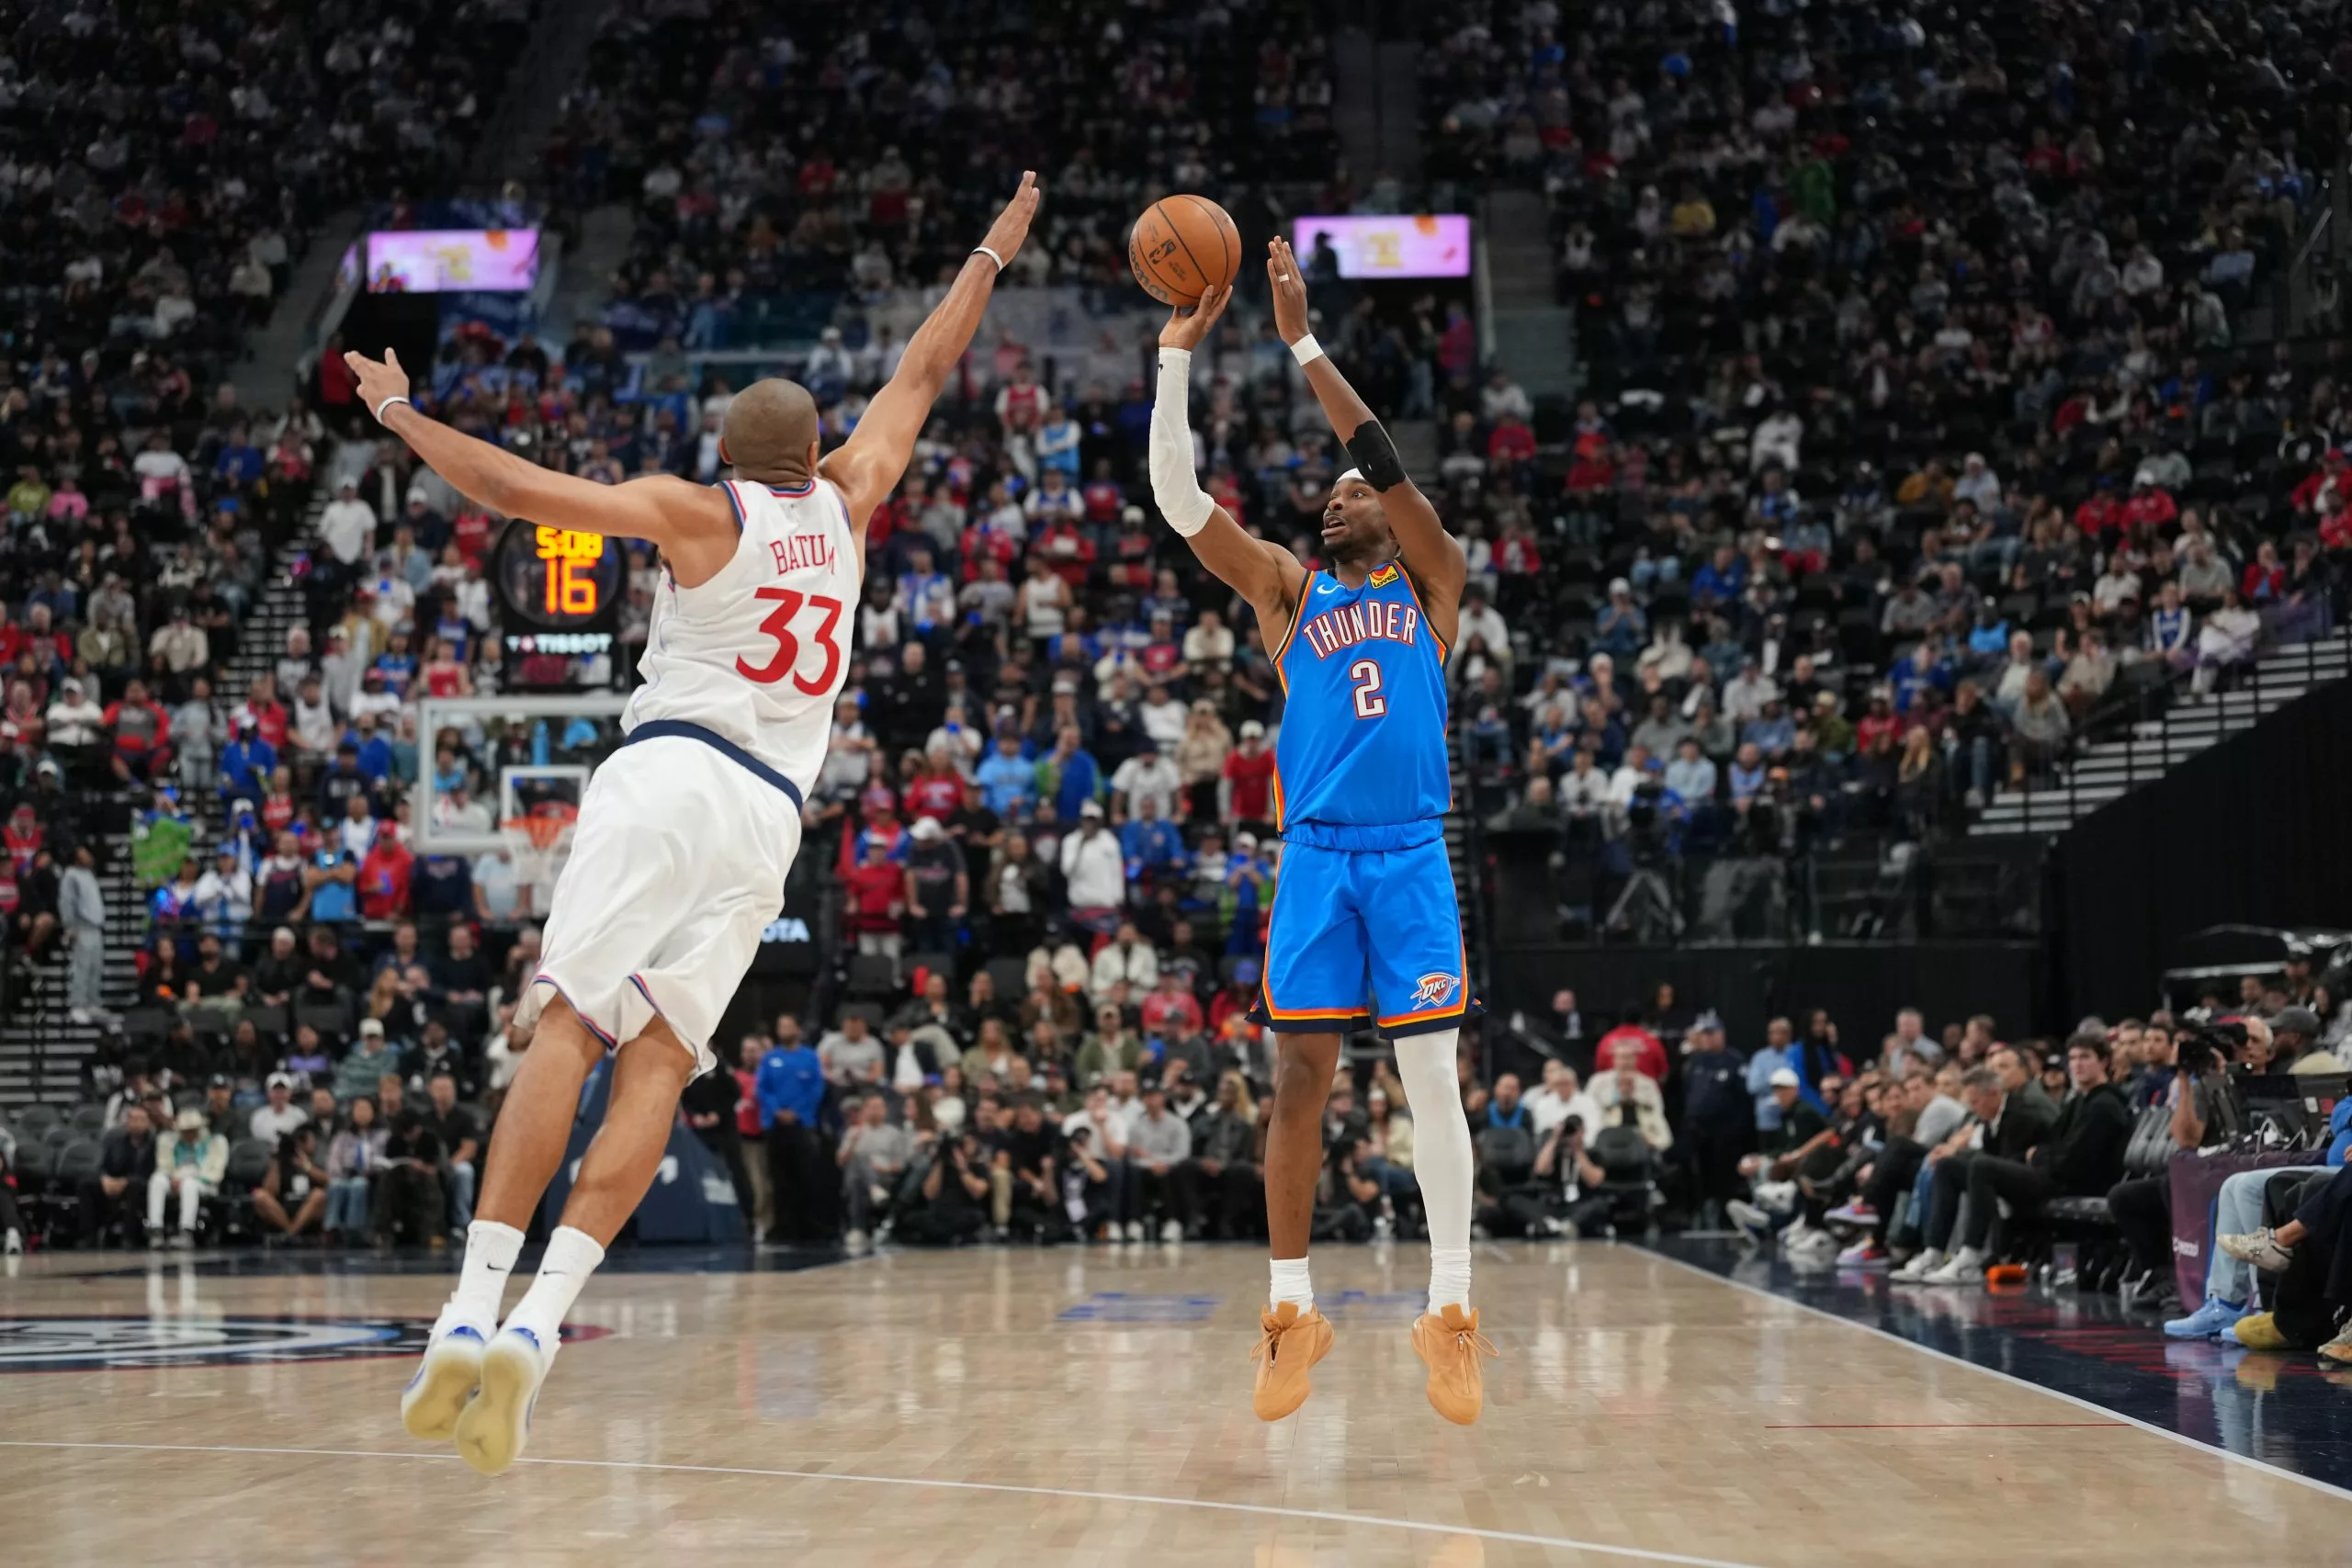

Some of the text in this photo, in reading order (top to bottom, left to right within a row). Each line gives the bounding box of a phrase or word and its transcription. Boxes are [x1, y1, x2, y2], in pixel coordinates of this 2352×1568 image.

[546, 558, 597, 615] 16
[535, 633, 613, 653] TISSOT
[735, 587, 842, 696] 33
[1303, 601, 1418, 660] THUNDER
[1350, 660, 1387, 719] 2
[1421, 979, 1446, 1001] OKC
